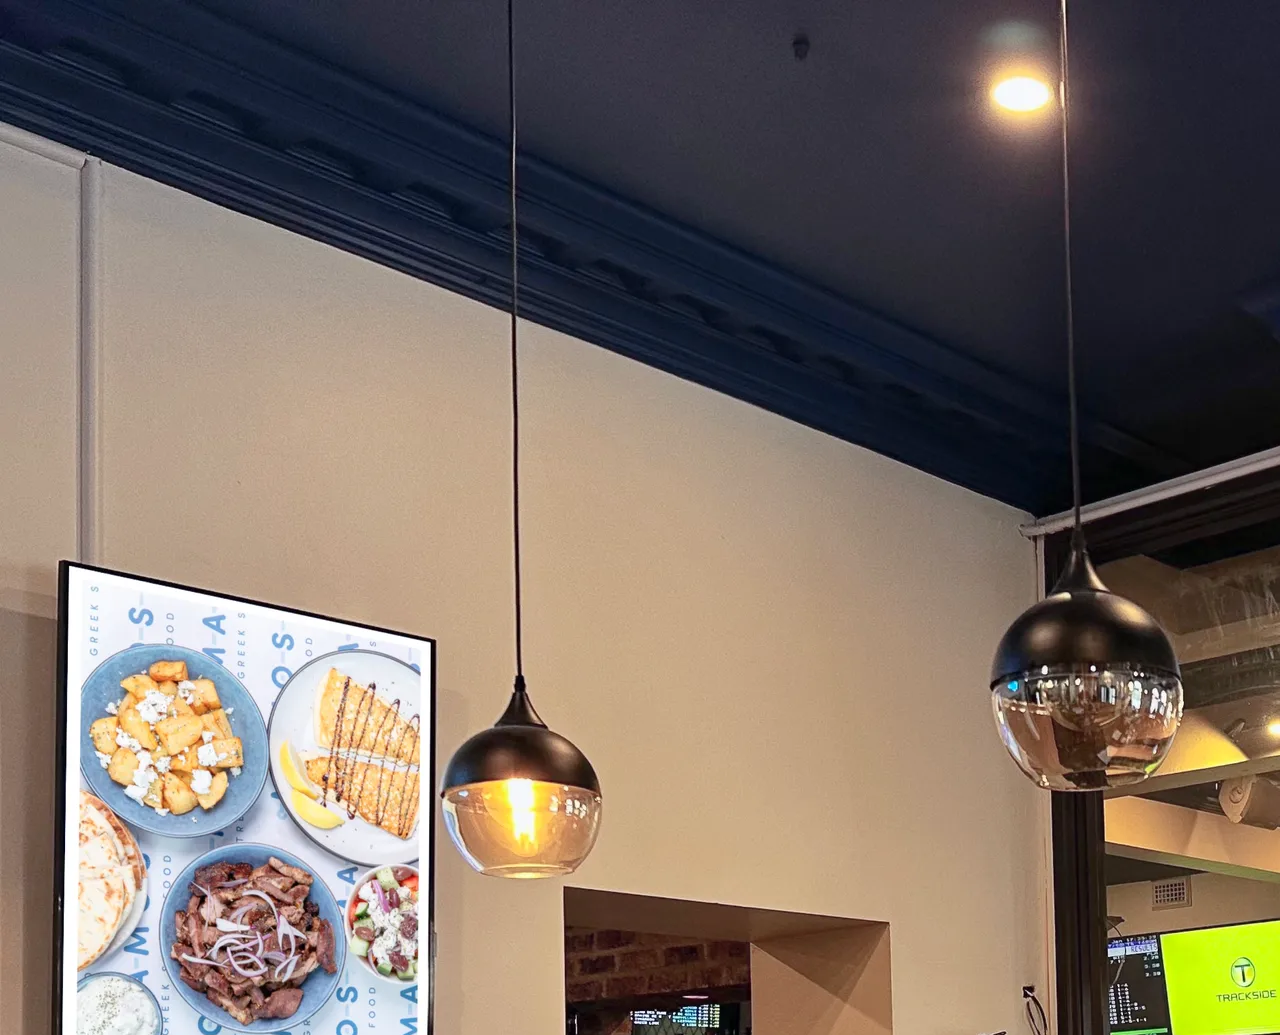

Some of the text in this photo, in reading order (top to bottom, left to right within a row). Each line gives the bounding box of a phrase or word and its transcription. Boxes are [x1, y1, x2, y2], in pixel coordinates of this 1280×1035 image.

[89, 603, 99, 657] GREEK
[237, 629, 246, 679] GREEK
[368, 987, 376, 1028] FOOD
[1216, 989, 1277, 1003] TRACKSIDE
